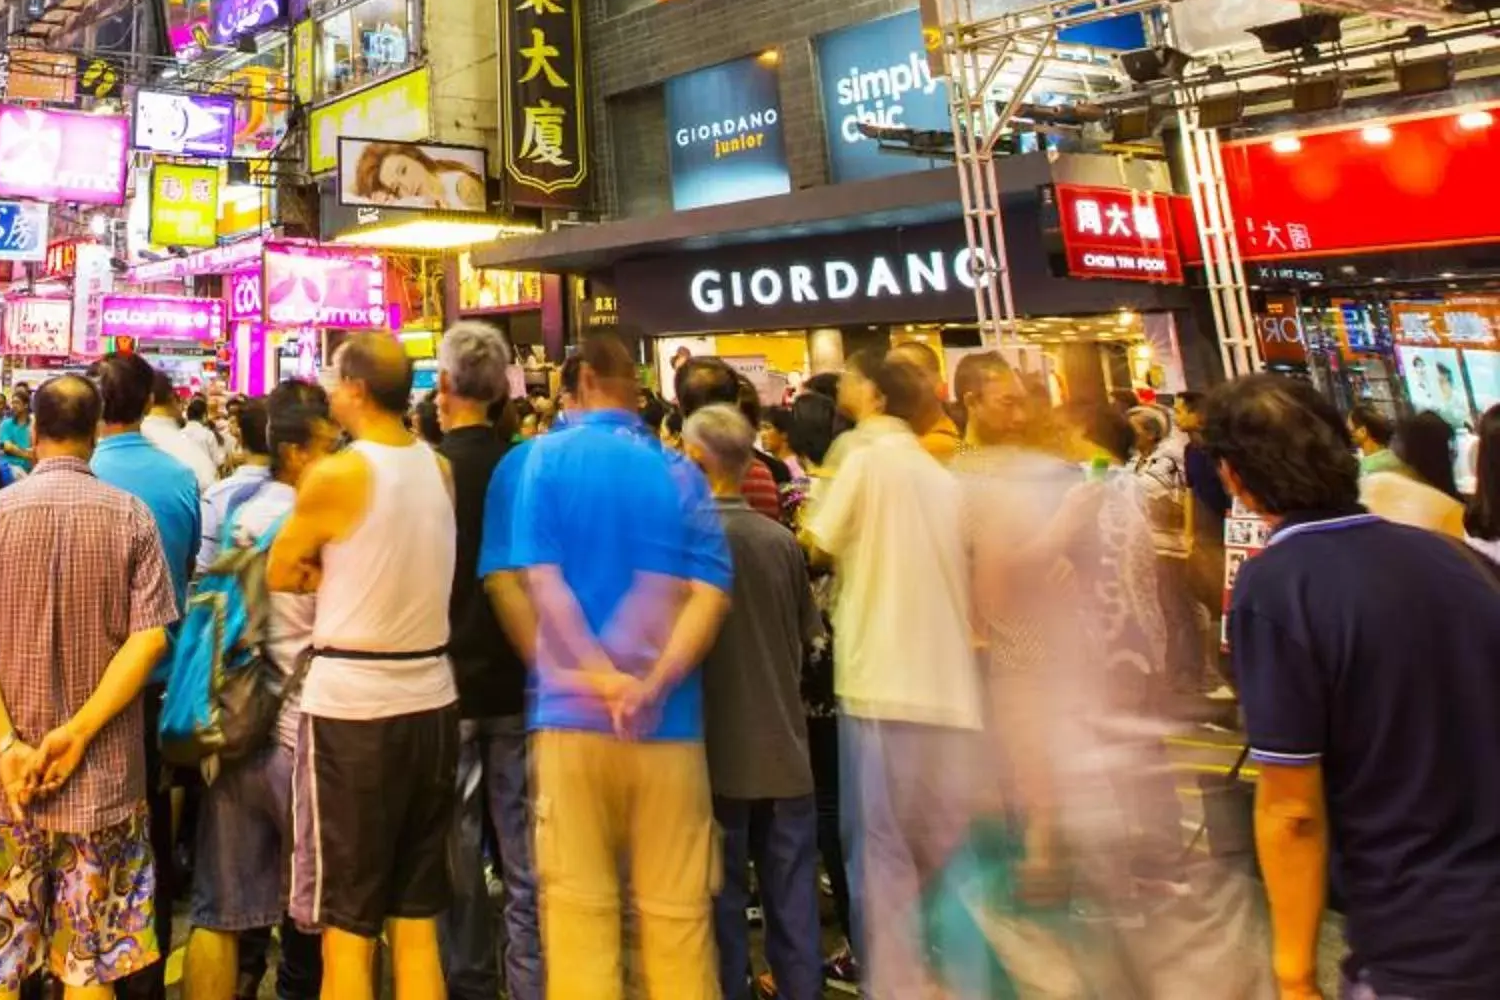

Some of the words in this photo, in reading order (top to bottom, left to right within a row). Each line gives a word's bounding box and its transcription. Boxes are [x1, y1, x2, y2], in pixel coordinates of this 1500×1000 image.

[837, 52, 937, 106] simply
[676, 107, 778, 148] GIORDANO
[714, 131, 764, 159] junior
[691, 244, 998, 315] GIORDANO
